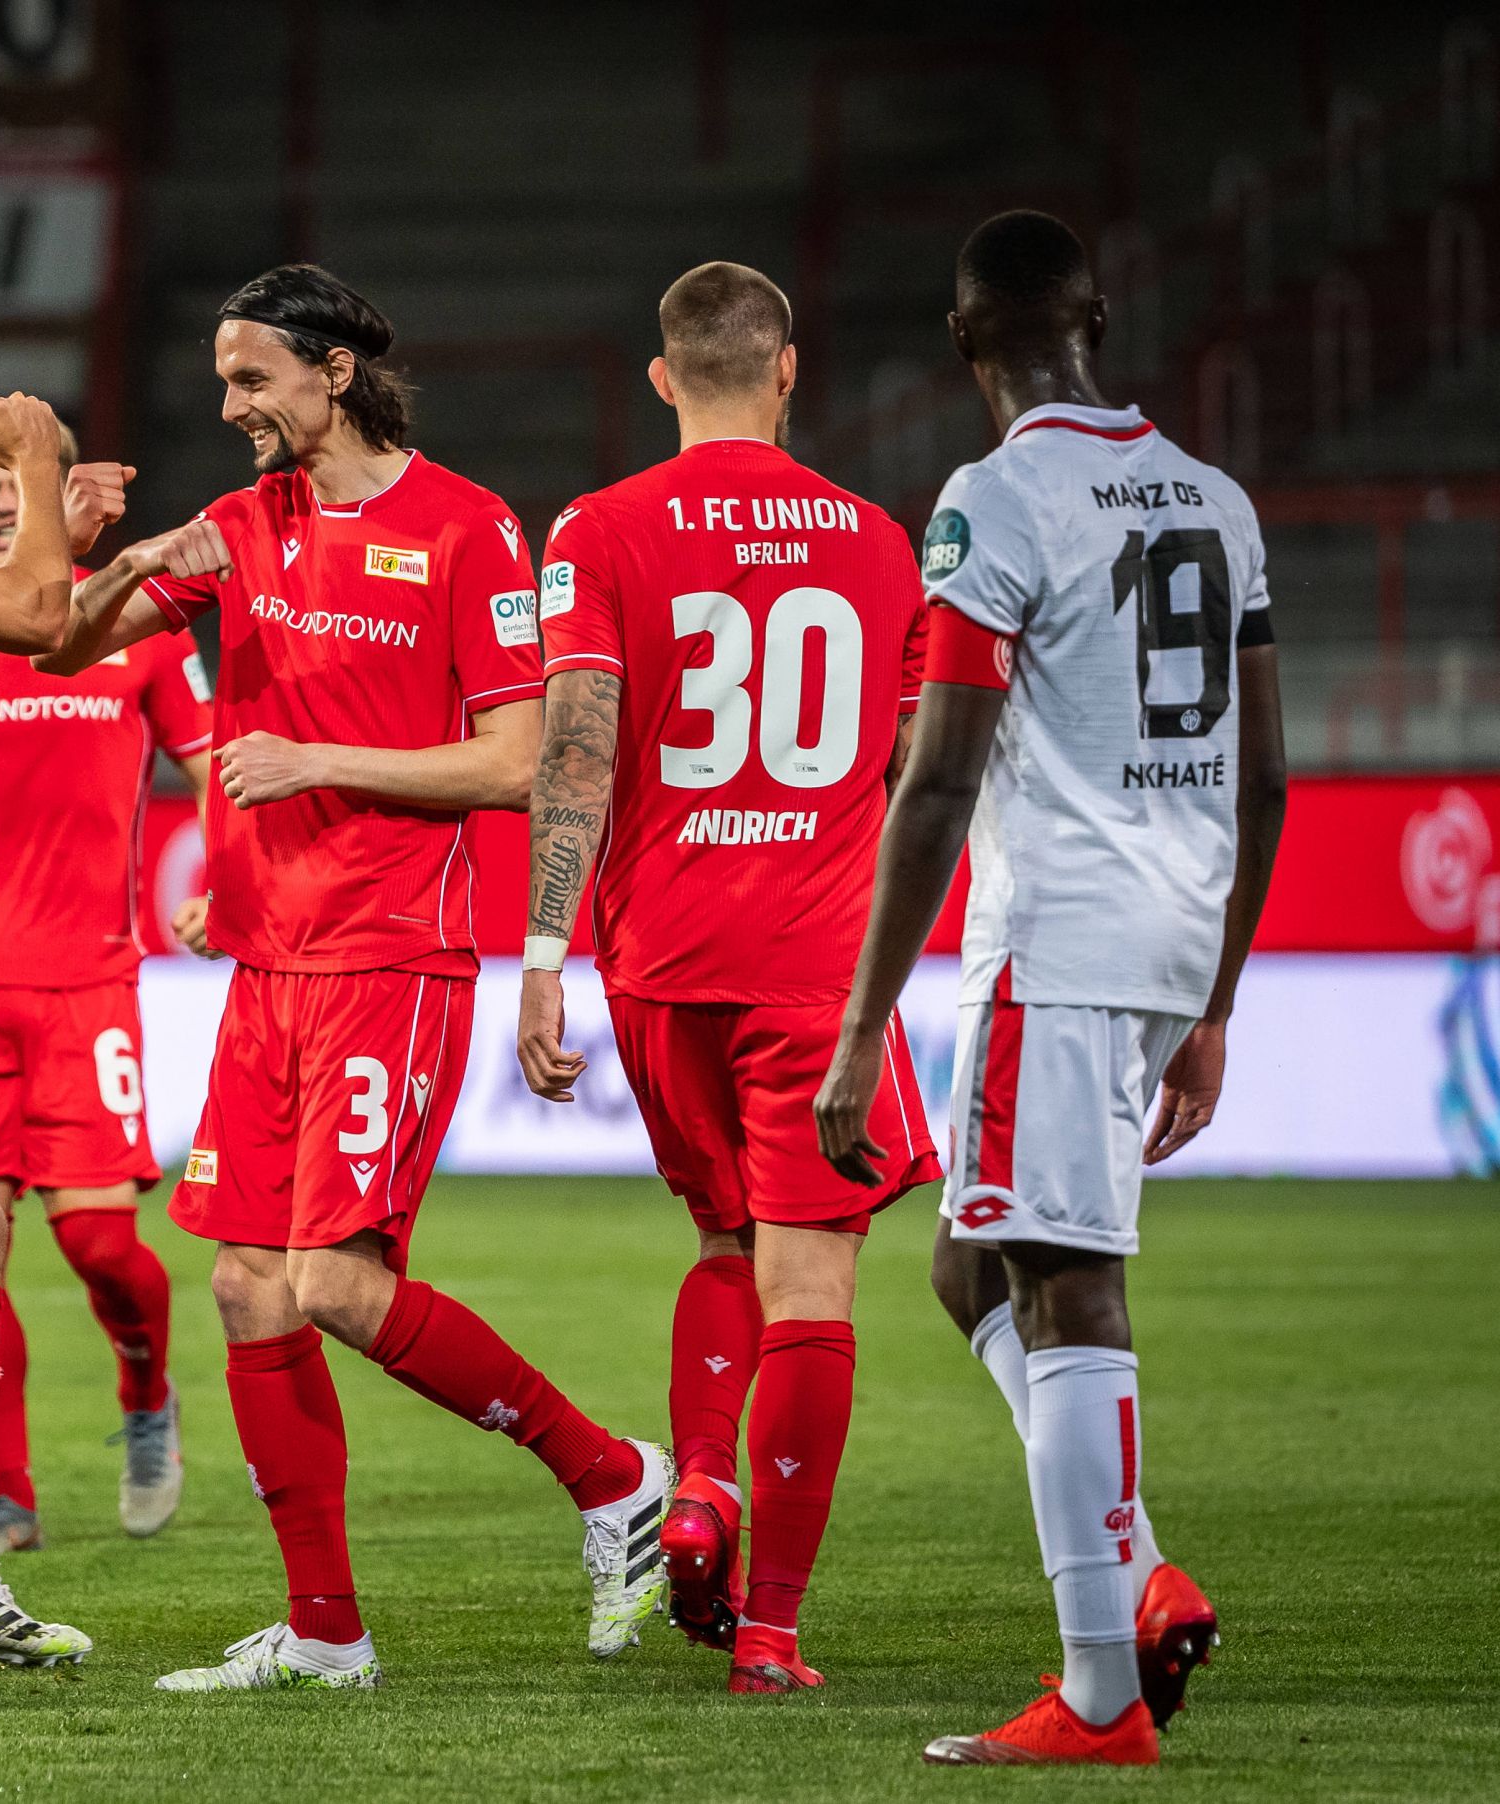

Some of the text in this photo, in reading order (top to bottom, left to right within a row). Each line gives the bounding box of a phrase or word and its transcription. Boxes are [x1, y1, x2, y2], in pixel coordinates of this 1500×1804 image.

[667, 497, 859, 533] 1. FC UNION
[1091, 483, 1170, 510] MANZ
[735, 541, 808, 565] BERLIN
[1110, 528, 1232, 740] 19
[659, 586, 863, 789] 30
[676, 808, 819, 845] ANDRICH
[93, 1027, 140, 1115] 6
[338, 1056, 389, 1155] 3
